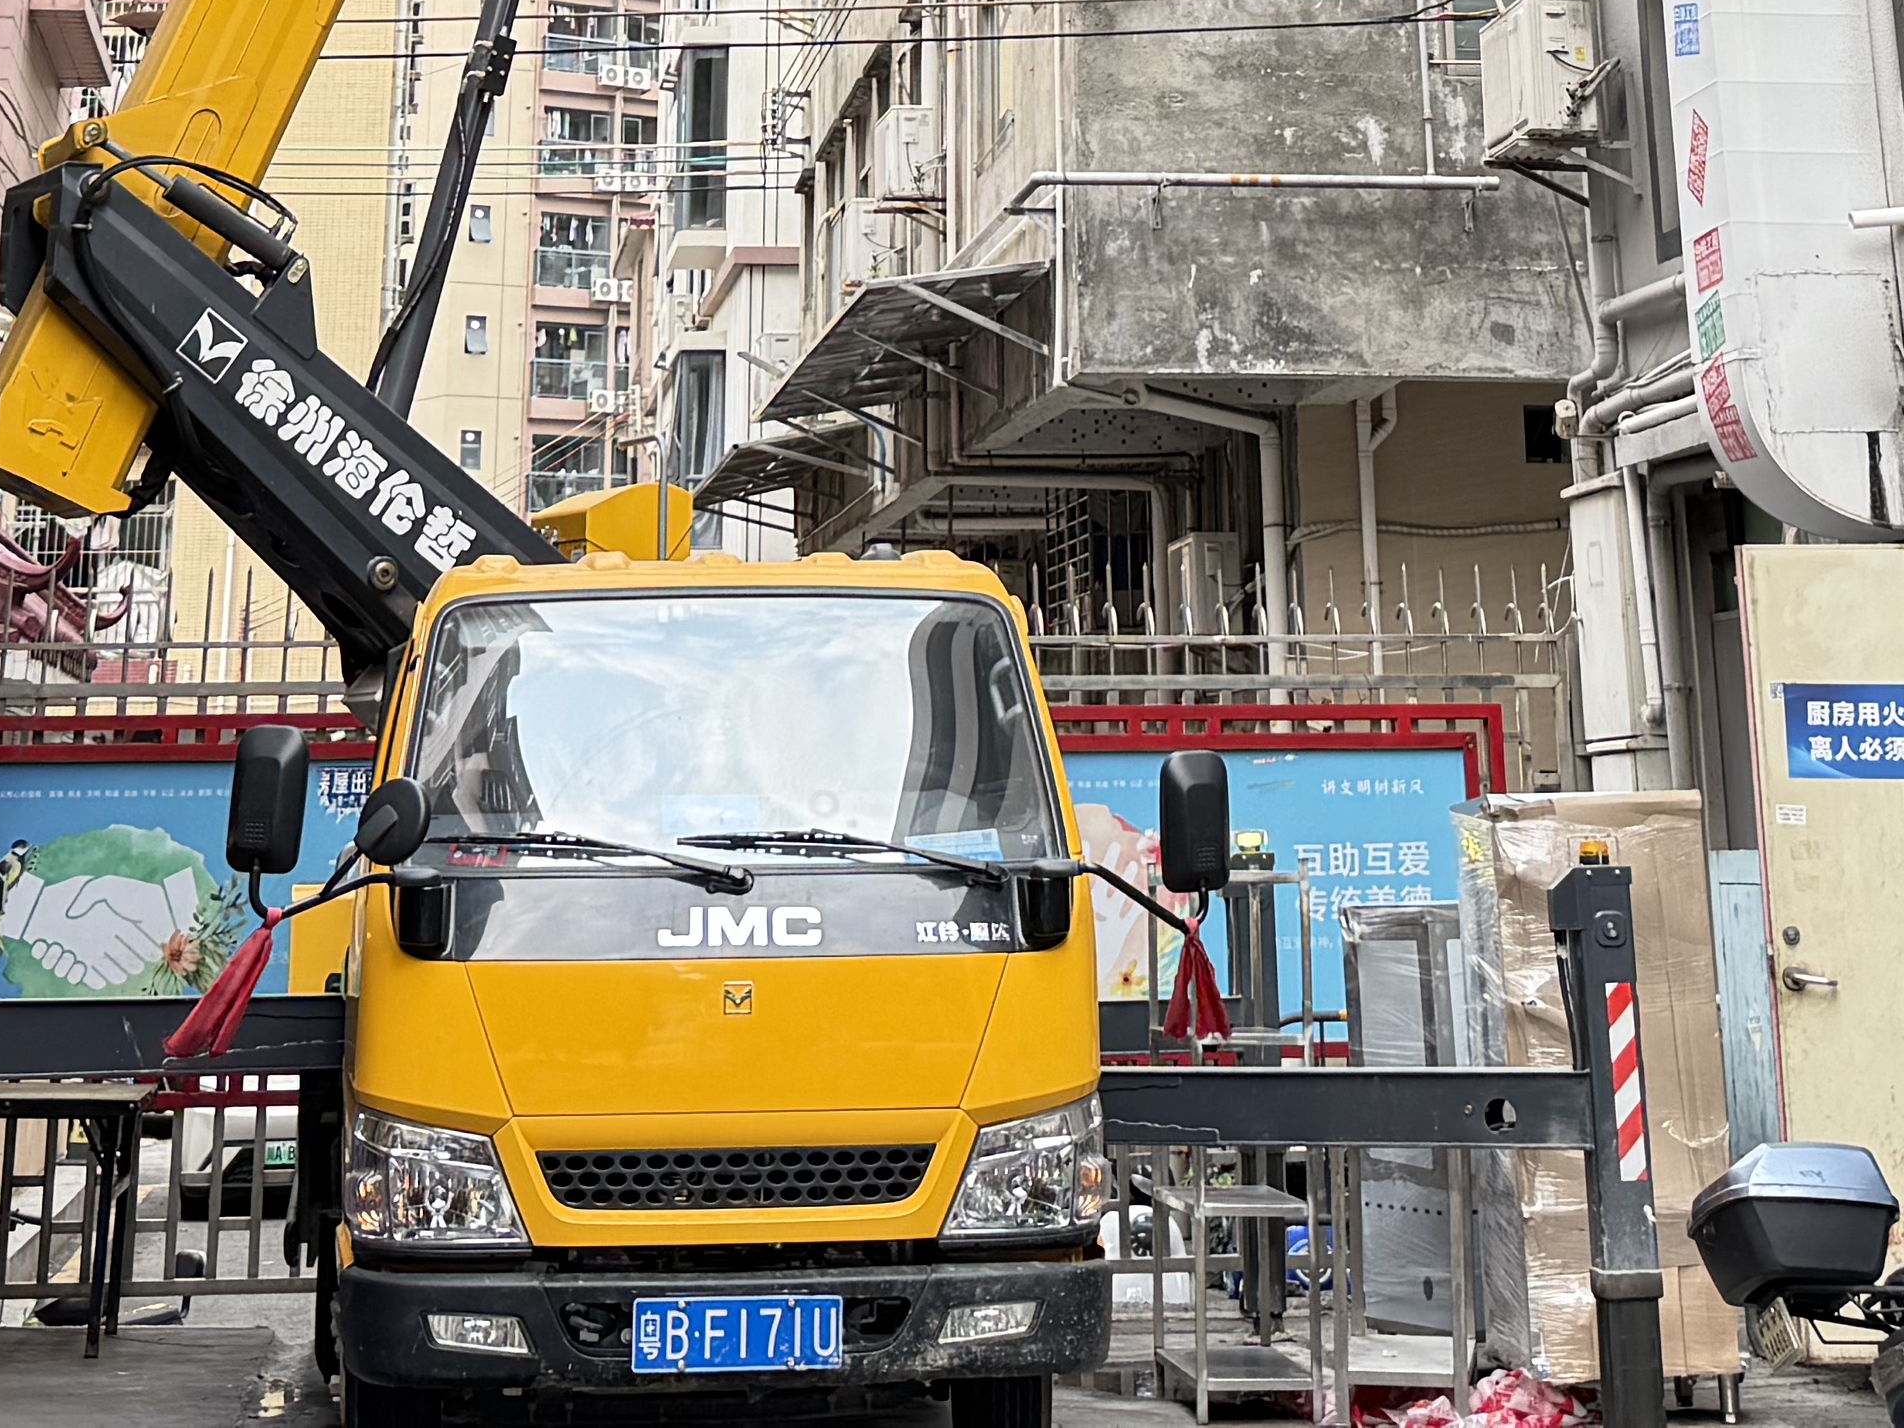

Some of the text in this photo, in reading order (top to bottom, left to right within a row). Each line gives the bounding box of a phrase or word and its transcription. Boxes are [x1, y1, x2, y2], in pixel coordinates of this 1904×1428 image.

[235, 359, 477, 572] 徐州海伦哲
[1321, 778, 1425, 795] 讲文明树新风
[1292, 841, 1431, 877] 互助互爱
[657, 906, 822, 947] JMC
